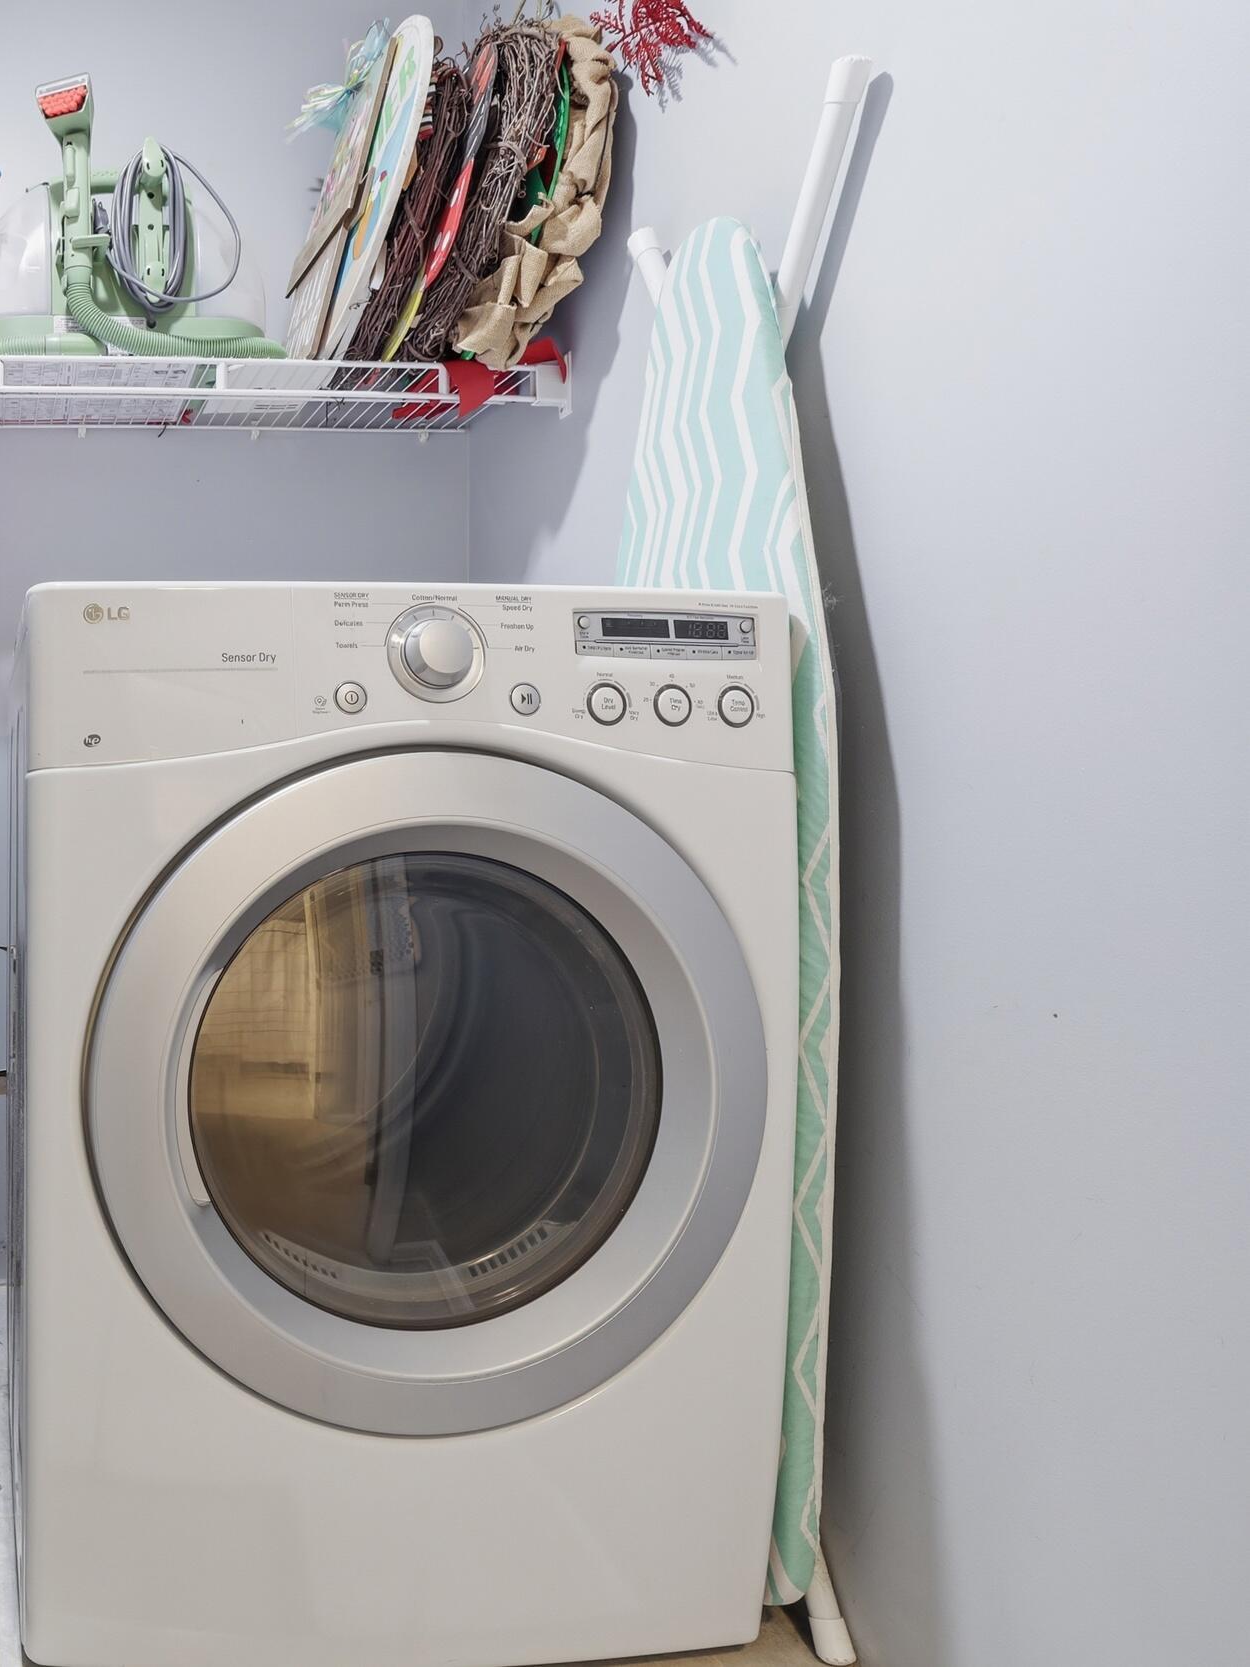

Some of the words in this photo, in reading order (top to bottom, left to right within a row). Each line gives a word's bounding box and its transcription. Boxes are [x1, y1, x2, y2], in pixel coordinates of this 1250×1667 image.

[412, 594, 458, 602] Cotton/Normal
[107, 606, 131, 621] LG
[221, 652, 257, 662] Sensor
[258, 652, 277, 665] Dry
